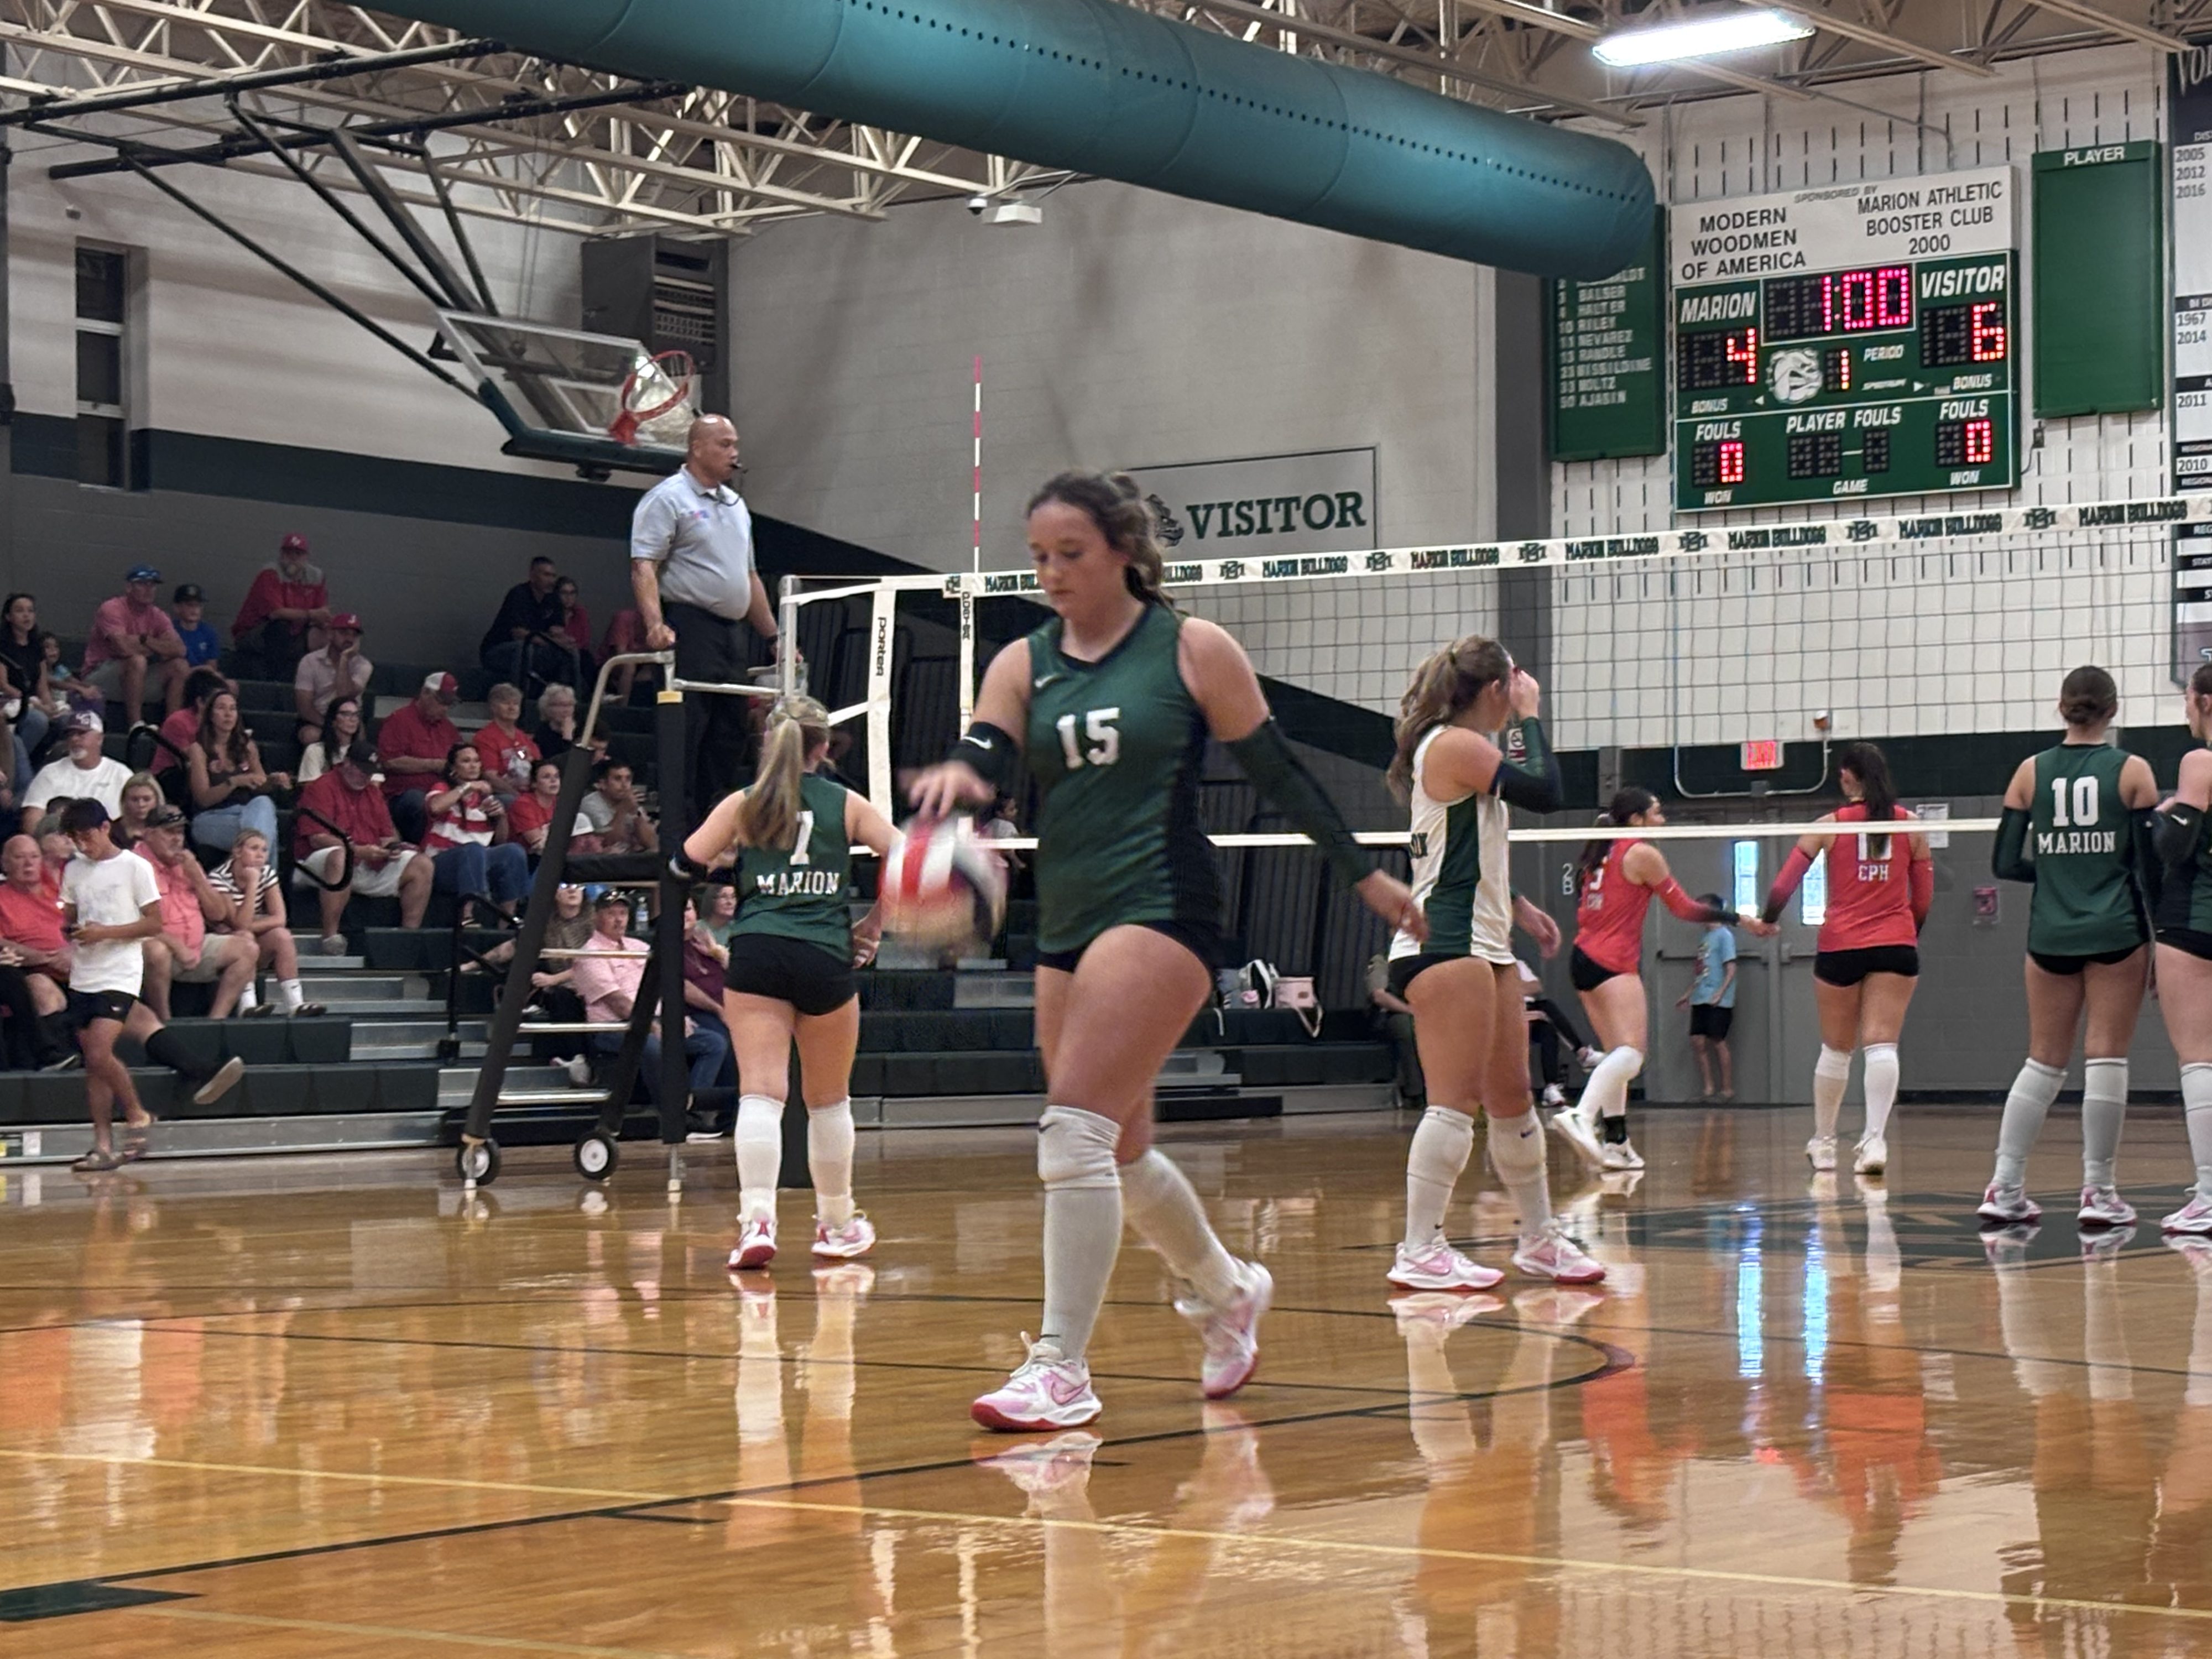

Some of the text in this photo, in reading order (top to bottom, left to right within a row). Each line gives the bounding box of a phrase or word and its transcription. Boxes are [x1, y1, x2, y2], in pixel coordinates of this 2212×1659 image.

[2063, 146, 2125, 166] PLAYER
[2175, 147, 2205, 163] 2005
[2176, 165, 2206, 181] 2012
[1858, 181, 2002, 214] MARION ATHLETIC
[1864, 185, 1878, 196] BY
[2176, 183, 2206, 199] 2016
[1700, 207, 1787, 233] MODERN
[1866, 206, 1994, 237] BOOSTER CLUB
[1691, 228, 1797, 256] WOODMEN
[1909, 234, 1950, 255] 2000
[1681, 251, 1807, 280] OF AMERICA
[1921, 265, 2005, 299] VISITOR
[1681, 291, 1756, 324] MARION
[2177, 312, 2207, 327] 1967
[1973, 302, 2005, 362] 6
[2177, 330, 2207, 345] 2014
[1726, 326, 1756, 384] 4
[1864, 344, 1905, 362] PERIOD
[1840, 348, 1850, 390] 1
[1953, 373, 1992, 391] BONUS
[1691, 398, 1729, 414] BONUS
[1939, 399, 1990, 420] FOULS
[2178, 394, 2207, 408] 2011
[1695, 421, 1742, 442] FOULS
[1786, 406, 1902, 434] PLAYER FOULS
[1966, 420, 1991, 463] 0
[1720, 442, 1743, 483] 0
[2178, 458, 2208, 473] 2010
[1833, 478, 1869, 495] GAME
[1950, 470, 1981, 486] WON
[1704, 489, 1733, 505] WON
[1186, 492, 1366, 540] VISITOR
[1056, 707, 1120, 770] 15
[2051, 775, 2099, 827] 10
[790, 810, 815, 866] 1
[2038, 831, 2117, 854] MARION
[756, 871, 841, 896] MARION
